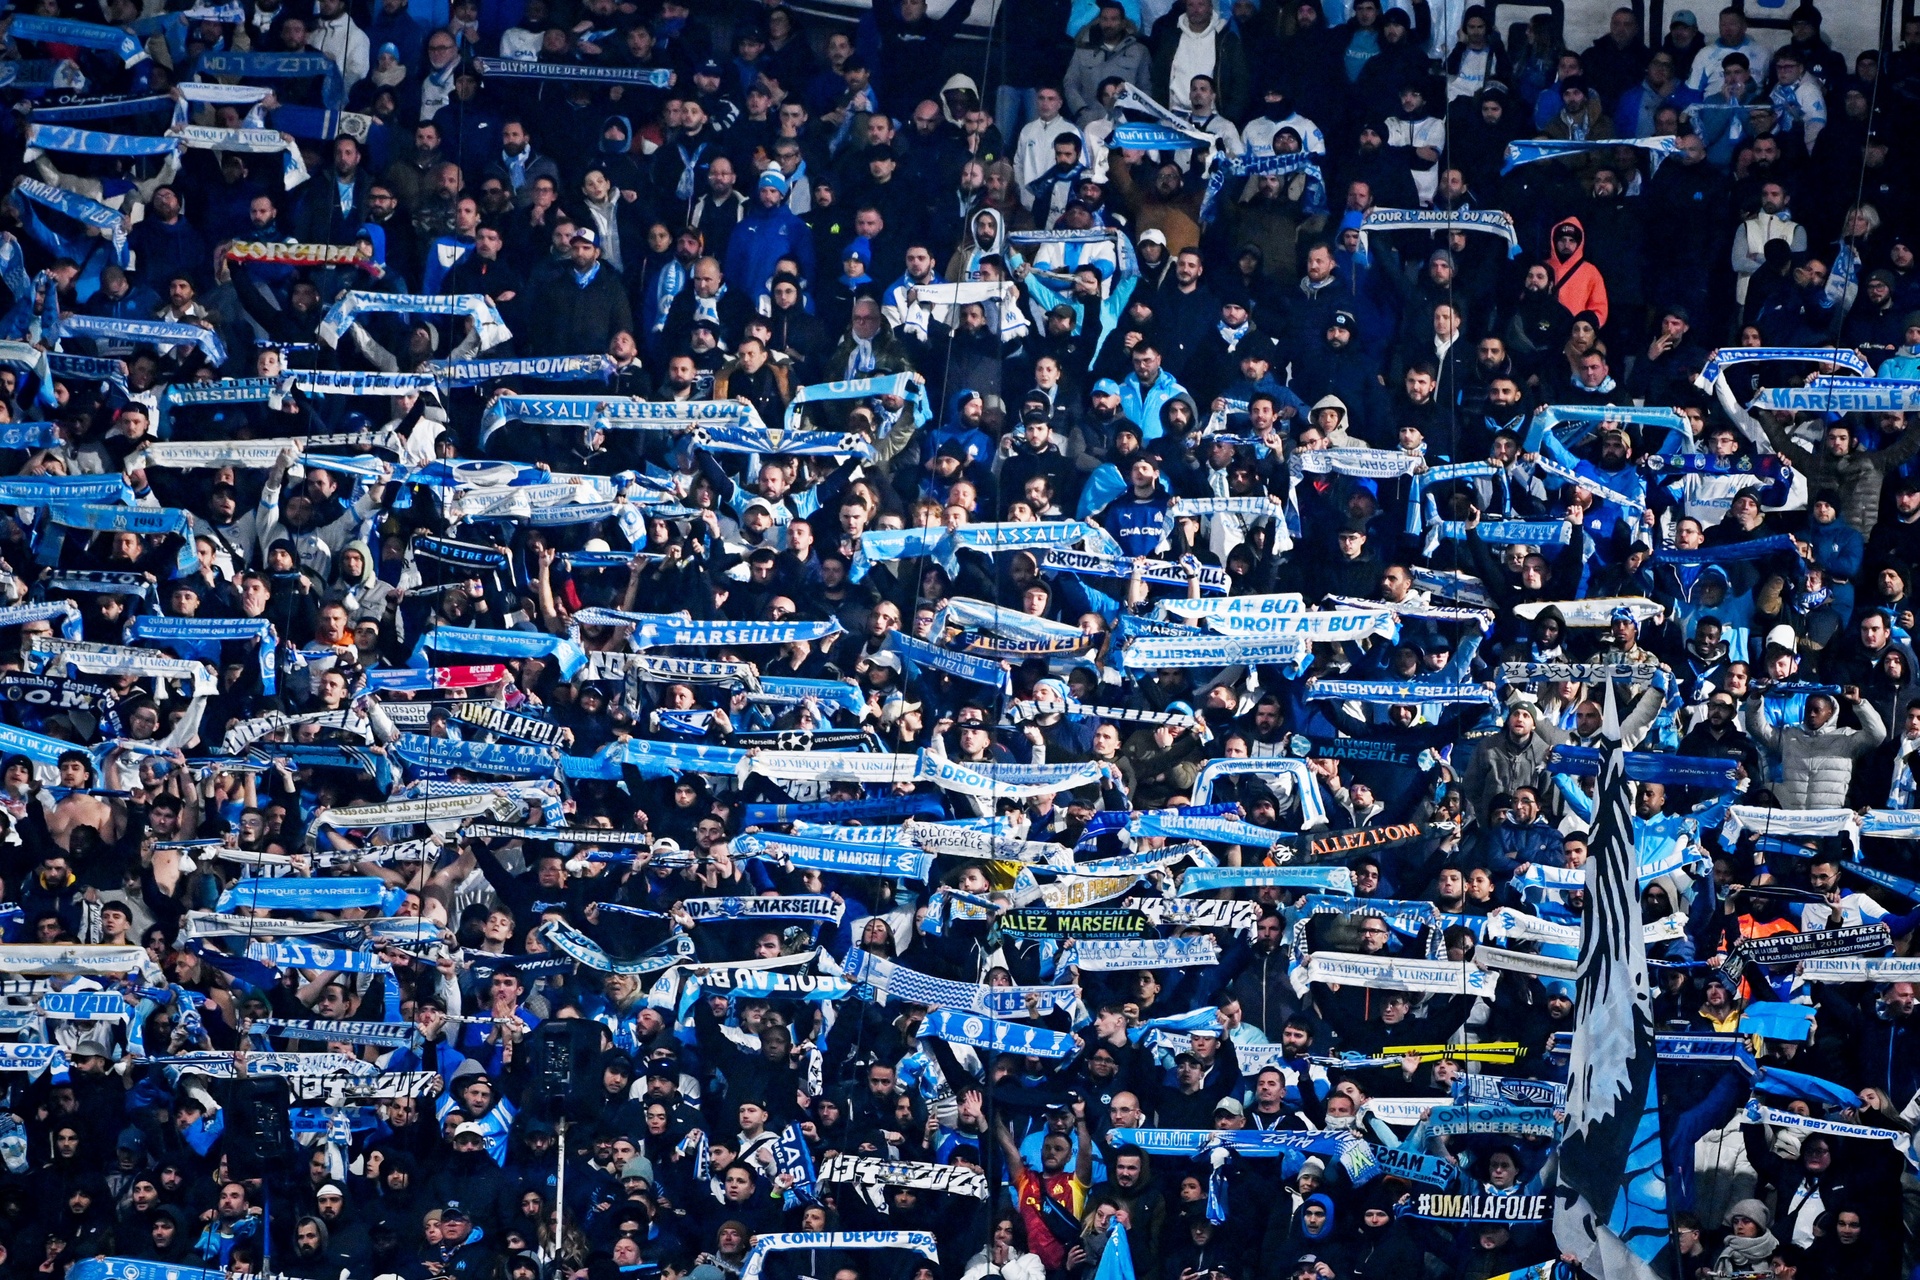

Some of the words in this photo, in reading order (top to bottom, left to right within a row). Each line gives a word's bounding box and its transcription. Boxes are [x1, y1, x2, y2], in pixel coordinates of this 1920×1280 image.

[500, 62, 561, 75] OLYMPIQUE
[1371, 212, 1402, 226] POUR
[1404, 210, 1458, 224] L'AMOUR
[1462, 212, 1479, 223] DU
[455, 360, 512, 379] ALLEZ
[519, 356, 570, 376] L'OM
[828, 377, 872, 393] OM
[1772, 388, 1903, 411] MARSEILLE
[134, 515, 164, 528] 1993
[975, 524, 1082, 545] MASSALIA
[1119, 527, 1140, 537] CMA
[1144, 564, 1227, 586] MARSILLE
[1229, 616, 1290, 634] DROIT
[1326, 613, 1371, 633] BUT
[674, 627, 796, 645] MARSEILLE
[645, 657, 739, 675] YANKEE
[932, 655, 957, 673] ALLEZ
[957, 660, 976, 677] L'OM
[62, 678, 103, 697] depuis
[748, 738, 777, 746] Marseille
[814, 736, 827, 745] UEFA
[828, 735, 860, 744] CHAMPIONS
[1333, 738, 1397, 751] OLYMPIQUE
[1318, 745, 1410, 765] MARSEILLE
[940, 764, 996, 788] DROIT
[547, 806, 562, 821] OM
[1159, 815, 1183, 828] UEFA
[1184, 817, 1244, 834] CHAMPIONS
[1309, 831, 1370, 856] ALLEZ
[1370, 822, 1420, 846] L'OM
[822, 848, 836, 862] DE
[836, 850, 892, 868] MARSEILLE
[1185, 868, 1241, 883] OLYMPIQUE
[1242, 868, 1254, 877] DE
[1256, 867, 1318, 878] MARSEILLE
[237, 886, 298, 897] OLYMPIQUE
[298, 887, 312, 897] DE
[313, 886, 371, 897] MARSEILLE
[753, 898, 839, 917] MARSEILLE
[1016, 909, 1054, 917] 100%
[1055, 909, 1130, 917] MARSEILLAIS
[1000, 915, 1047, 931] ALLEZ
[1058, 915, 1145, 932] MARSEILLE
[1083, 932, 1140, 940] MARSEILLAIS
[1815, 931, 1834, 942] DE
[1819, 938, 1845, 949] 2010
[4, 954, 66, 966] OLYMPIQUE
[82, 951, 141, 965] MARSEILLE
[734, 967, 768, 992] AU
[1317, 961, 1379, 978] OLYMPIQUE
[1396, 967, 1457, 983] MARSEILLE
[312, 1020, 407, 1038] MARSEILLE
[14, 1044, 53, 1057] OM
[991, 1041, 1005, 1051] DE
[1008, 1044, 1066, 1058] MARSEILLE
[1439, 1105, 1467, 1122] OM
[1478, 1103, 1511, 1121] OM
[1519, 1103, 1553, 1121] OM
[1433, 1122, 1499, 1136] OLYMPIQUE
[1500, 1122, 1517, 1135] DE
[1522, 1122, 1554, 1137] MARS
[1769, 1112, 1801, 1126] CAOM
[1802, 1117, 1828, 1130] 1987
[1828, 1121, 1868, 1135] VIRAGE
[1869, 1127, 1900, 1142] NORD
[1418, 1193, 1546, 1220] #OMALAFOLIE
[843, 1230, 899, 1244] DEPUIS
